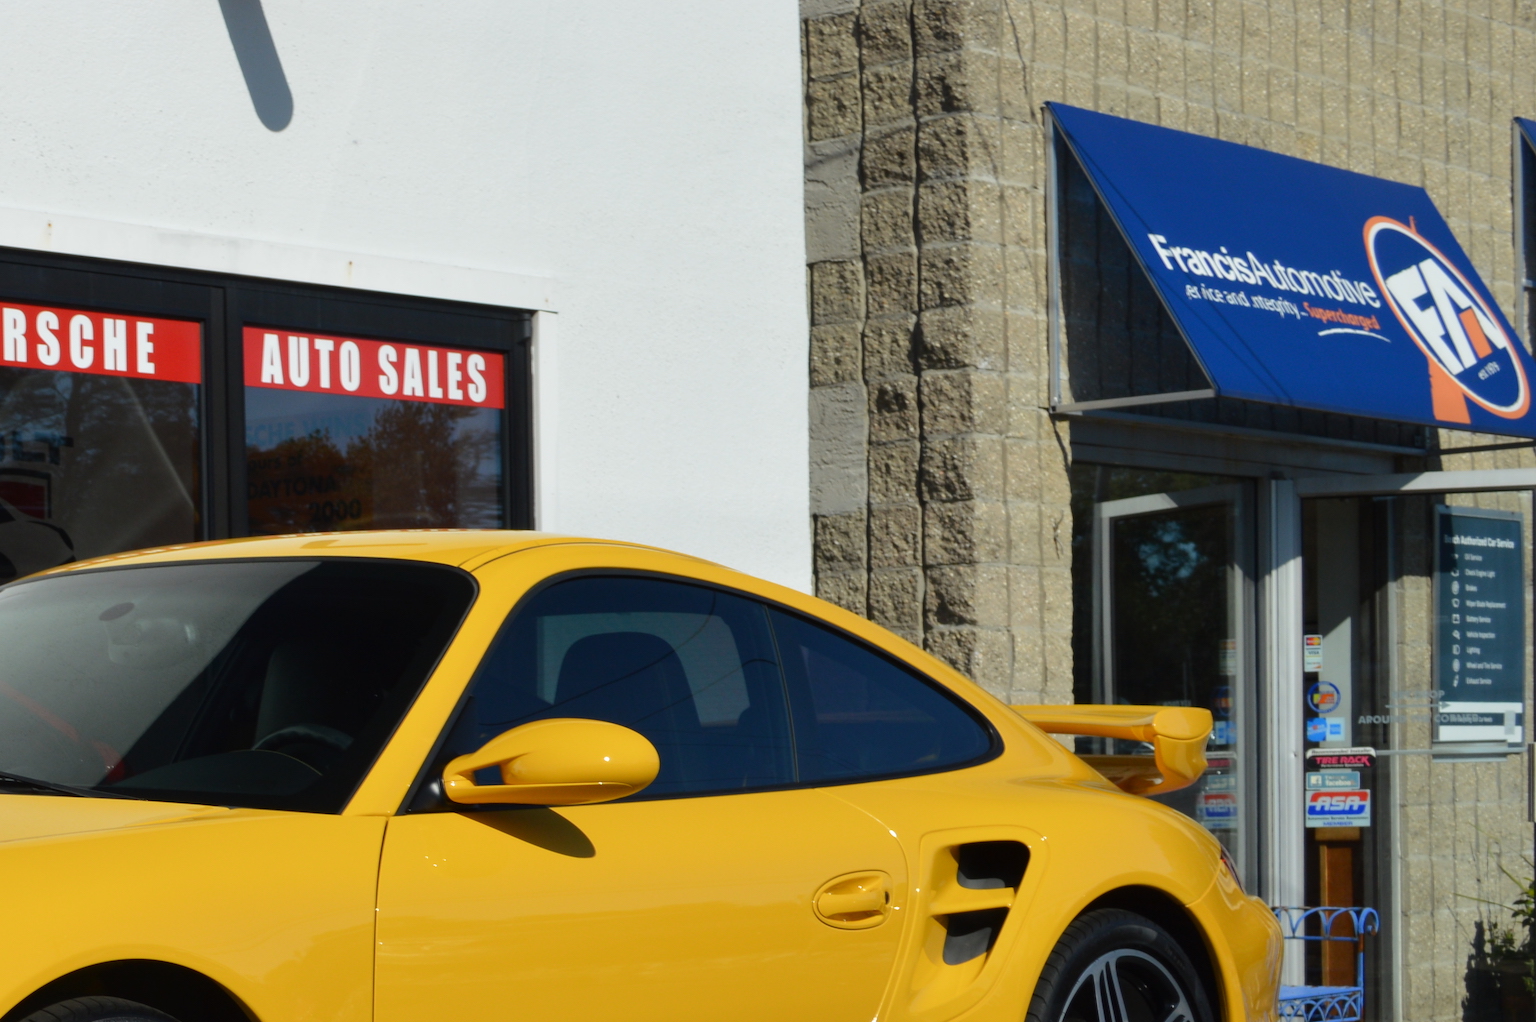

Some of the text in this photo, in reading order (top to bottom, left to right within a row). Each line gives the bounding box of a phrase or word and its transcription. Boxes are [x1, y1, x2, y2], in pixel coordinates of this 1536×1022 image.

[261, 332, 488, 403] AUTO SALES
[1461, 536, 1487, 547] Authorized
[1488, 537, 1496, 547] Car
[1497, 538, 1515, 549] Service
[1315, 755, 1371, 767] TIRE RACK
[1315, 795, 1361, 811] ASA
